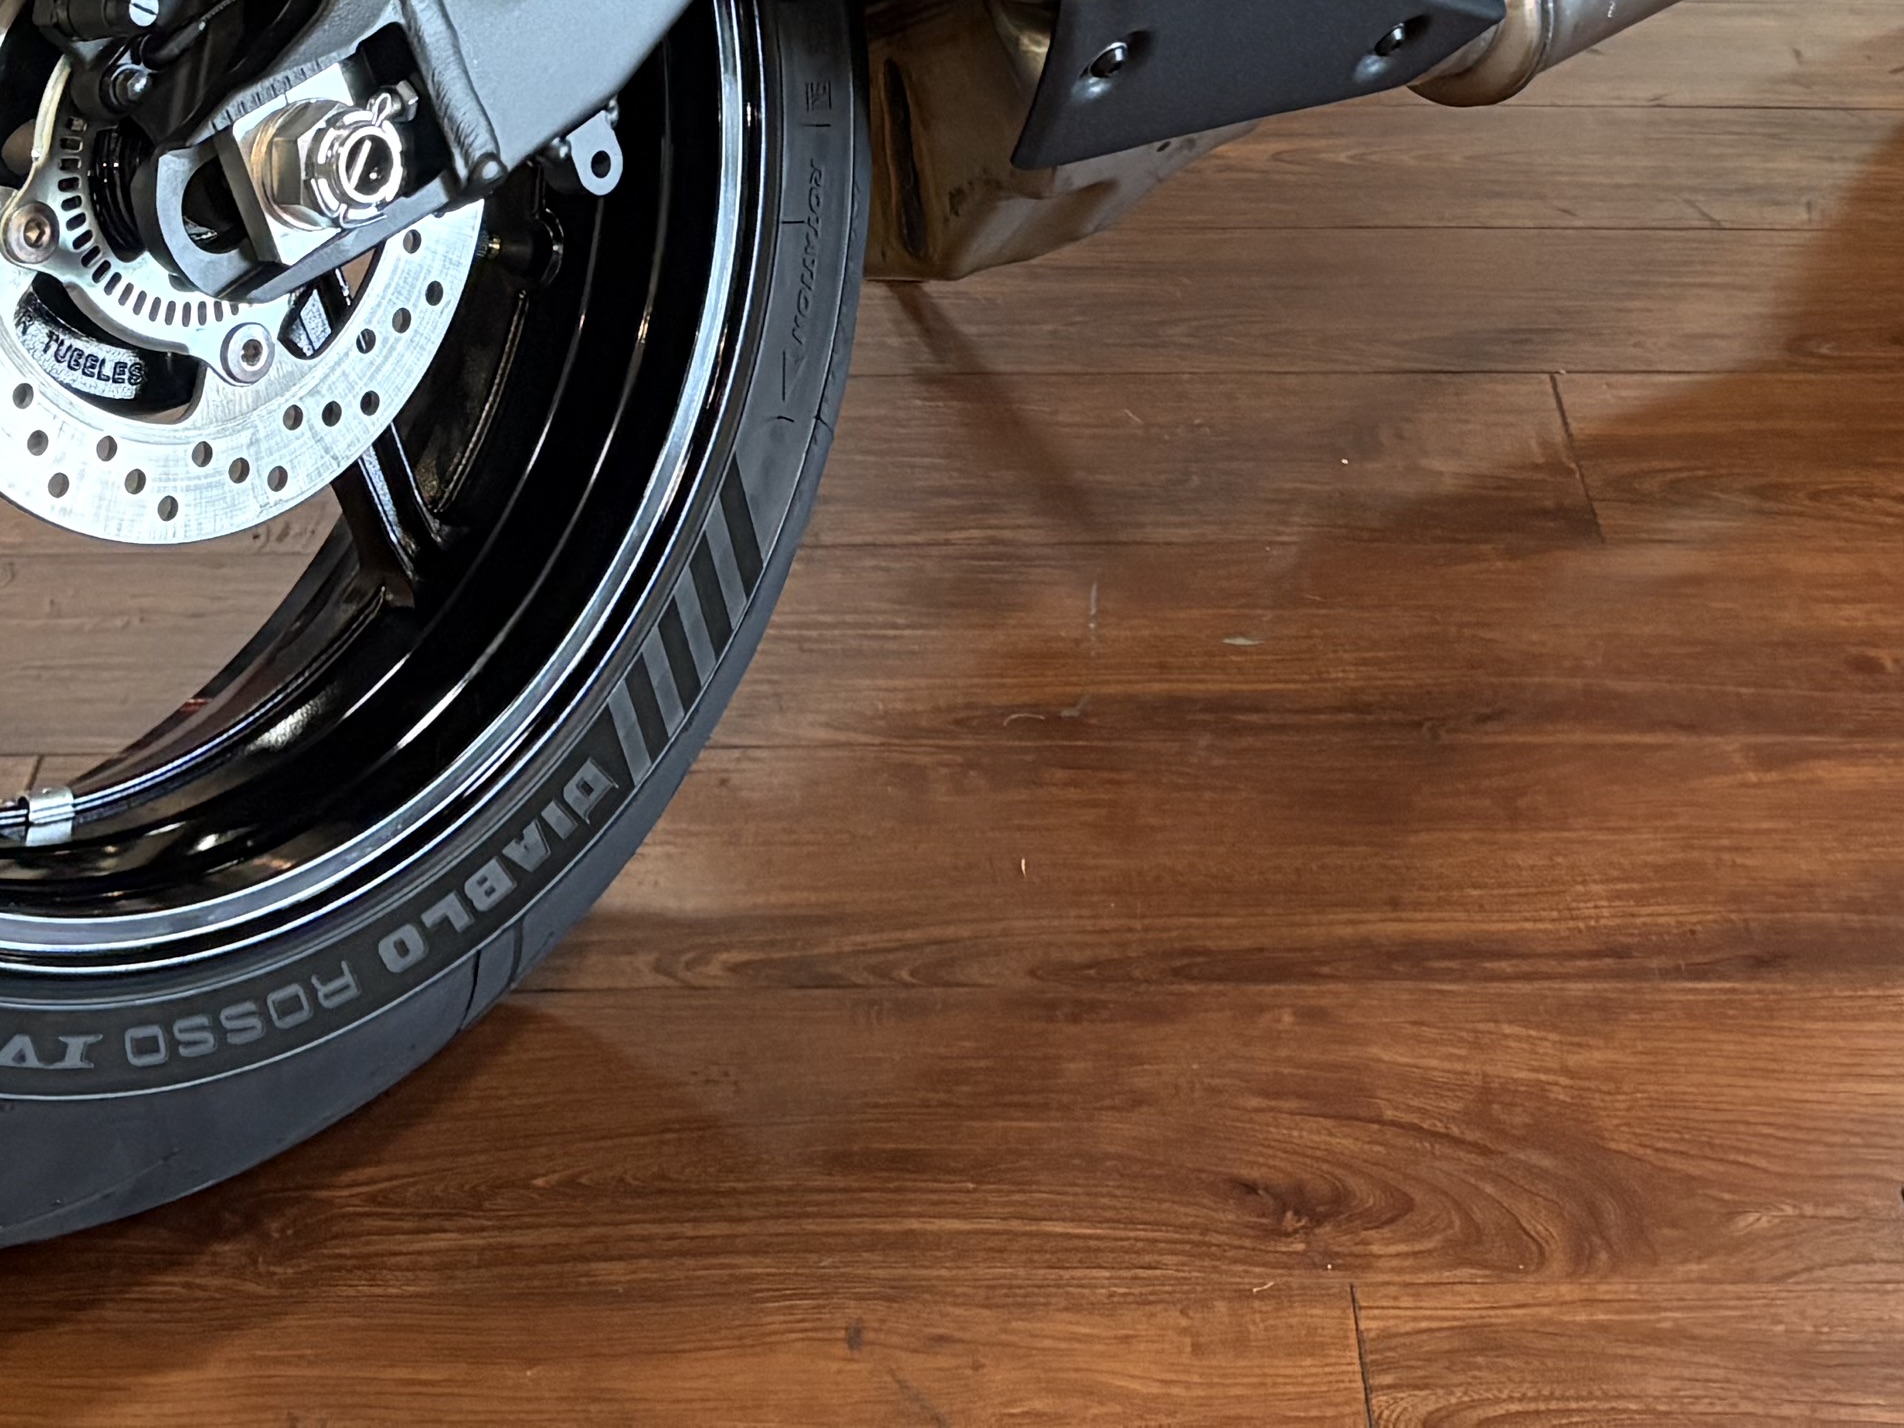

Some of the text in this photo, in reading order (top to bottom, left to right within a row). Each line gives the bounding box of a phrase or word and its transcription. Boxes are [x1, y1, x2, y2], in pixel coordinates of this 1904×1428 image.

[41, 328, 147, 388] TUBELES
[377, 756, 620, 975] DIABLO
[123, 959, 363, 1068] ROSSO
